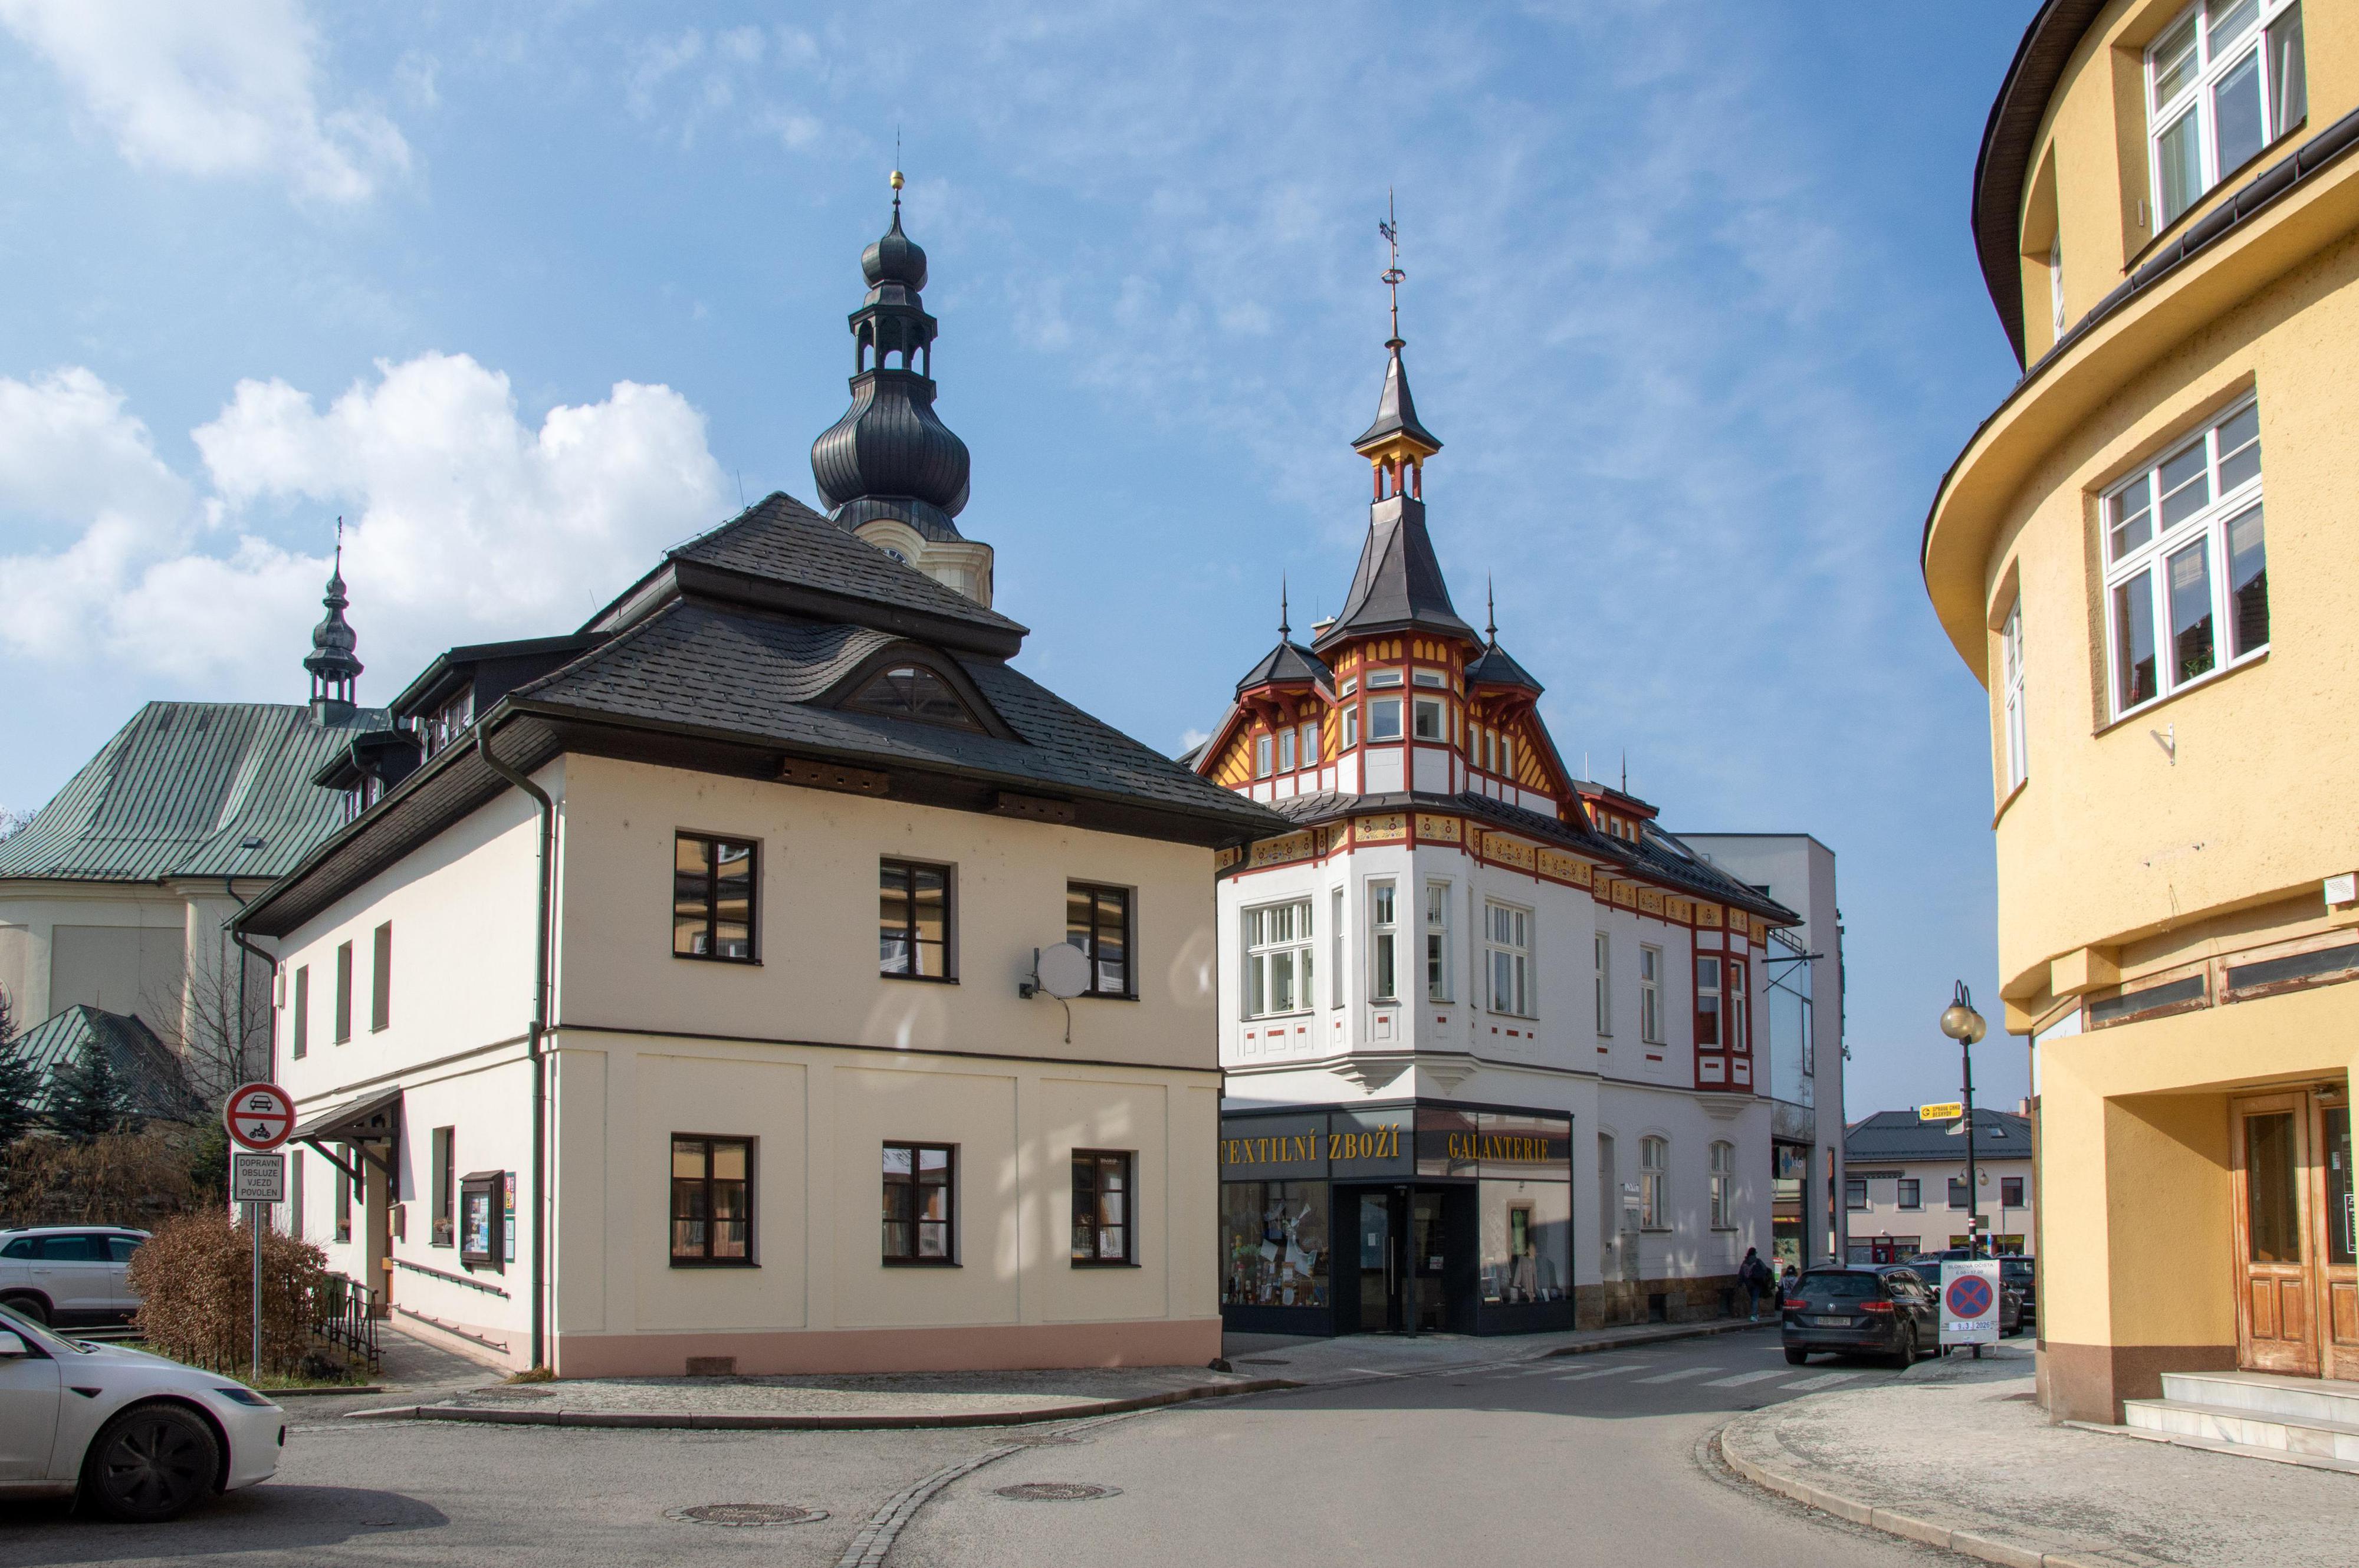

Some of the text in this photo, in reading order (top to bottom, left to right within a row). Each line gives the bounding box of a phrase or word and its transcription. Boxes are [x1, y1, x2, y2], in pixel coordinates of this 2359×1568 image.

[1329, 1123, 1399, 1160] ZBOŽÍ
[1448, 1132, 1549, 1163] GALANTERIE
[240, 1158, 280, 1167] DOPRAVNÍ
[242, 1169, 278, 1177] OBSLUZE
[241, 1188, 278, 1196] POVOLEN
